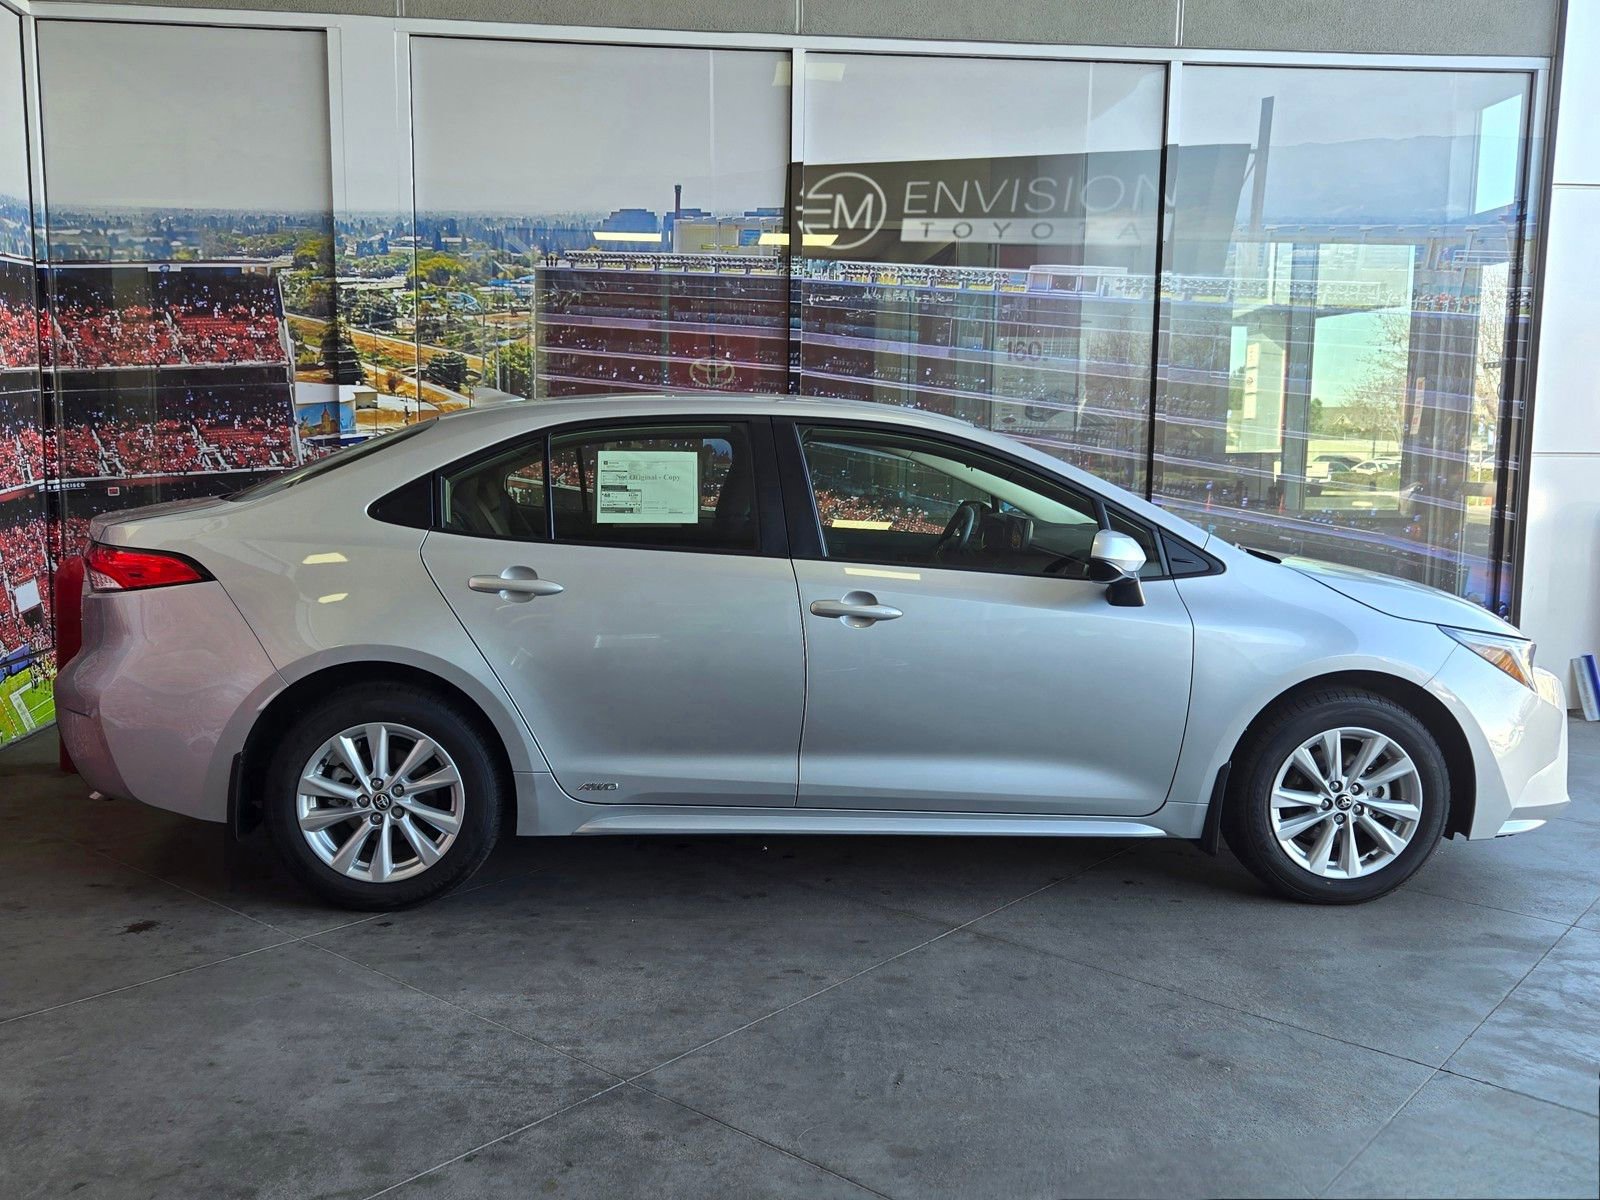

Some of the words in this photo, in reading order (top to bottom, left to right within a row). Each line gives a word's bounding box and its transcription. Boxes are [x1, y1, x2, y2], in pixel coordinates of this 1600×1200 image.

[903, 174, 1177, 214] ENVISION
[663, 474, 680, 482] Copy
[577, 782, 619, 791] AWD
